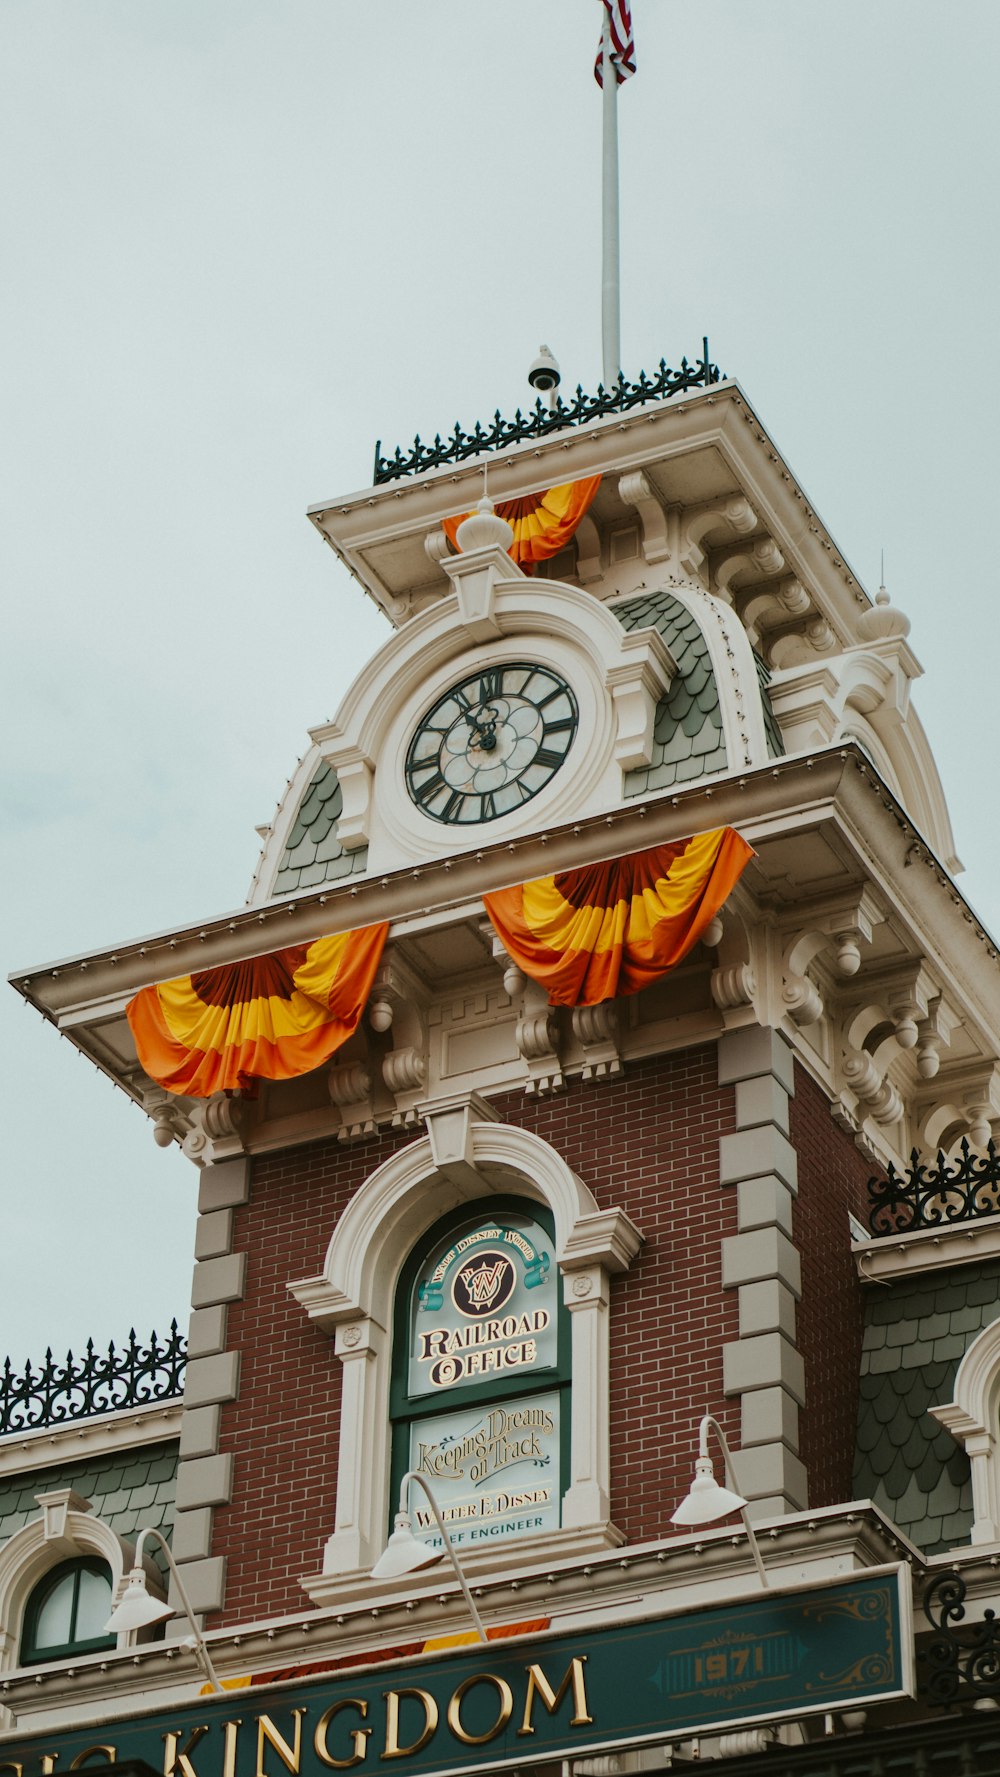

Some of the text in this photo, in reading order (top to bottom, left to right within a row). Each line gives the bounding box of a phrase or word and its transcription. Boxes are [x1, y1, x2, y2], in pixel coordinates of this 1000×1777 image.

[431, 1229, 535, 1284] WALT DISNEY WORLD
[417, 1309, 550, 1362] RAILROAD
[430, 1340, 536, 1387] OFFICE
[416, 1409, 554, 1478] Keeping Dreams
[469, 1431, 543, 1481] on Track
[495, 1489, 551, 1513] DISNEY
[471, 1518, 543, 1540] ENGINEER
[695, 1646, 763, 1693] 1971
[161, 1654, 594, 1777] KINGDOM
